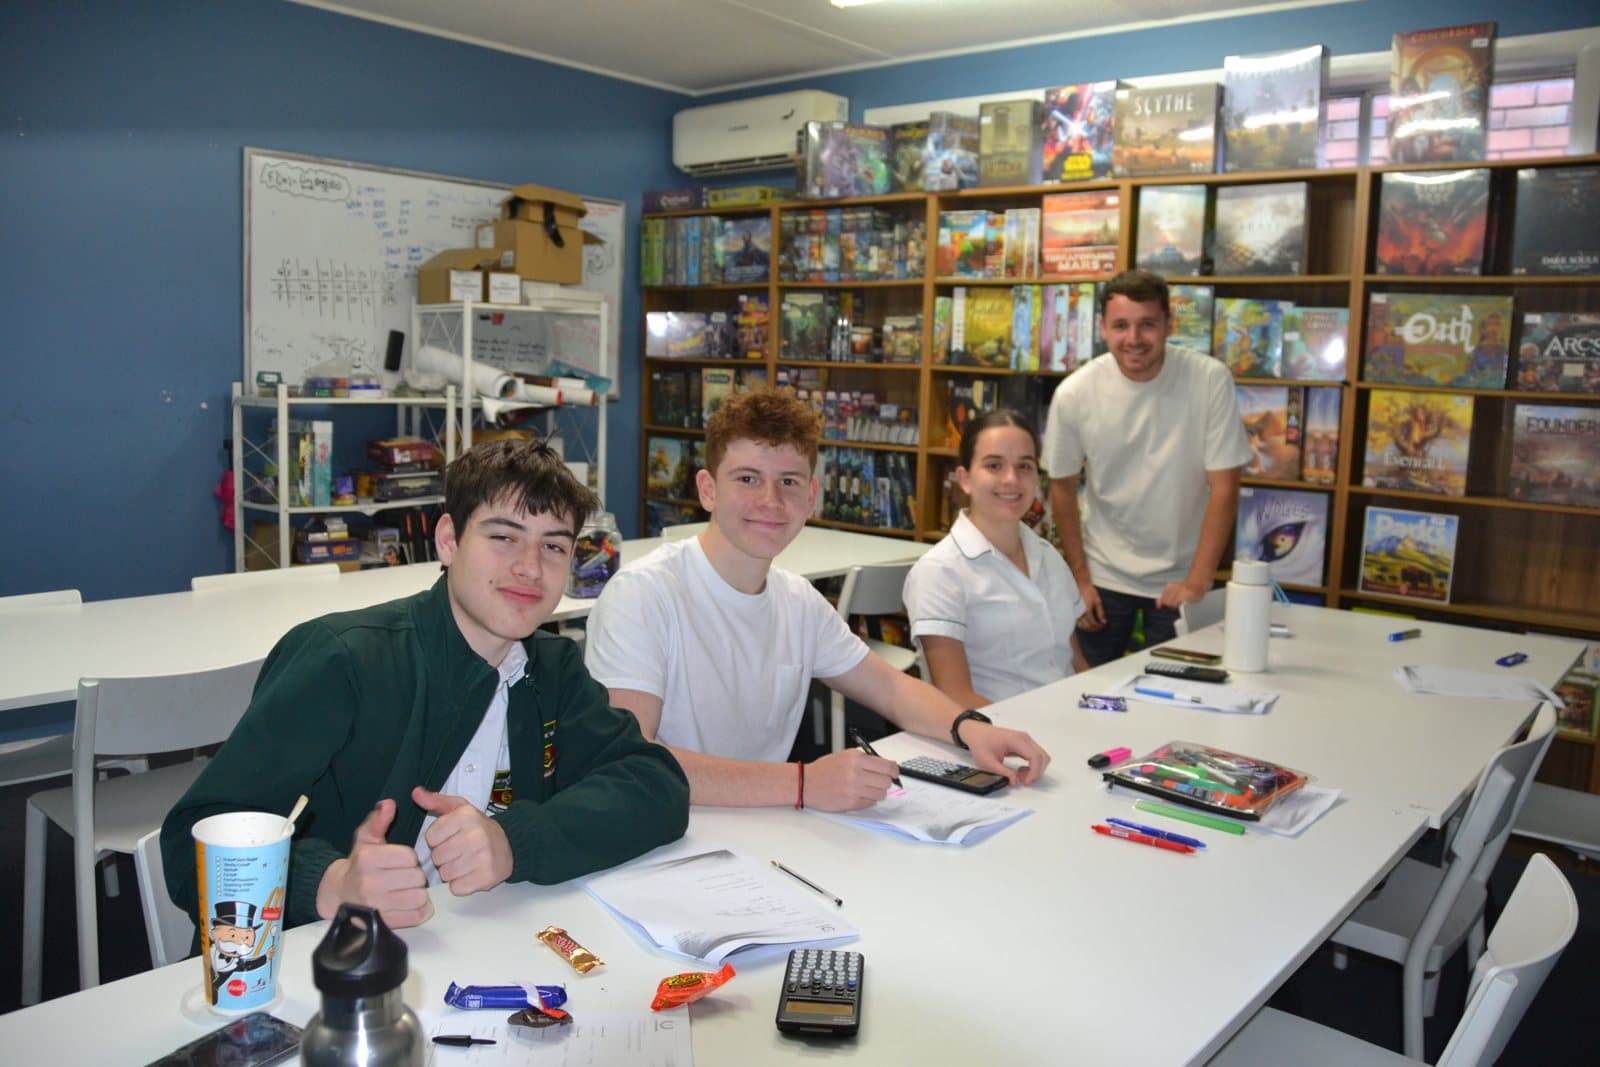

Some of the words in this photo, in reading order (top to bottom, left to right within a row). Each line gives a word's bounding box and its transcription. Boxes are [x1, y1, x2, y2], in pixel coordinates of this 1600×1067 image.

[1134, 92, 1195, 115] SCYTHE
[1057, 259, 1100, 272] MARS
[1394, 304, 1475, 353] Oath
